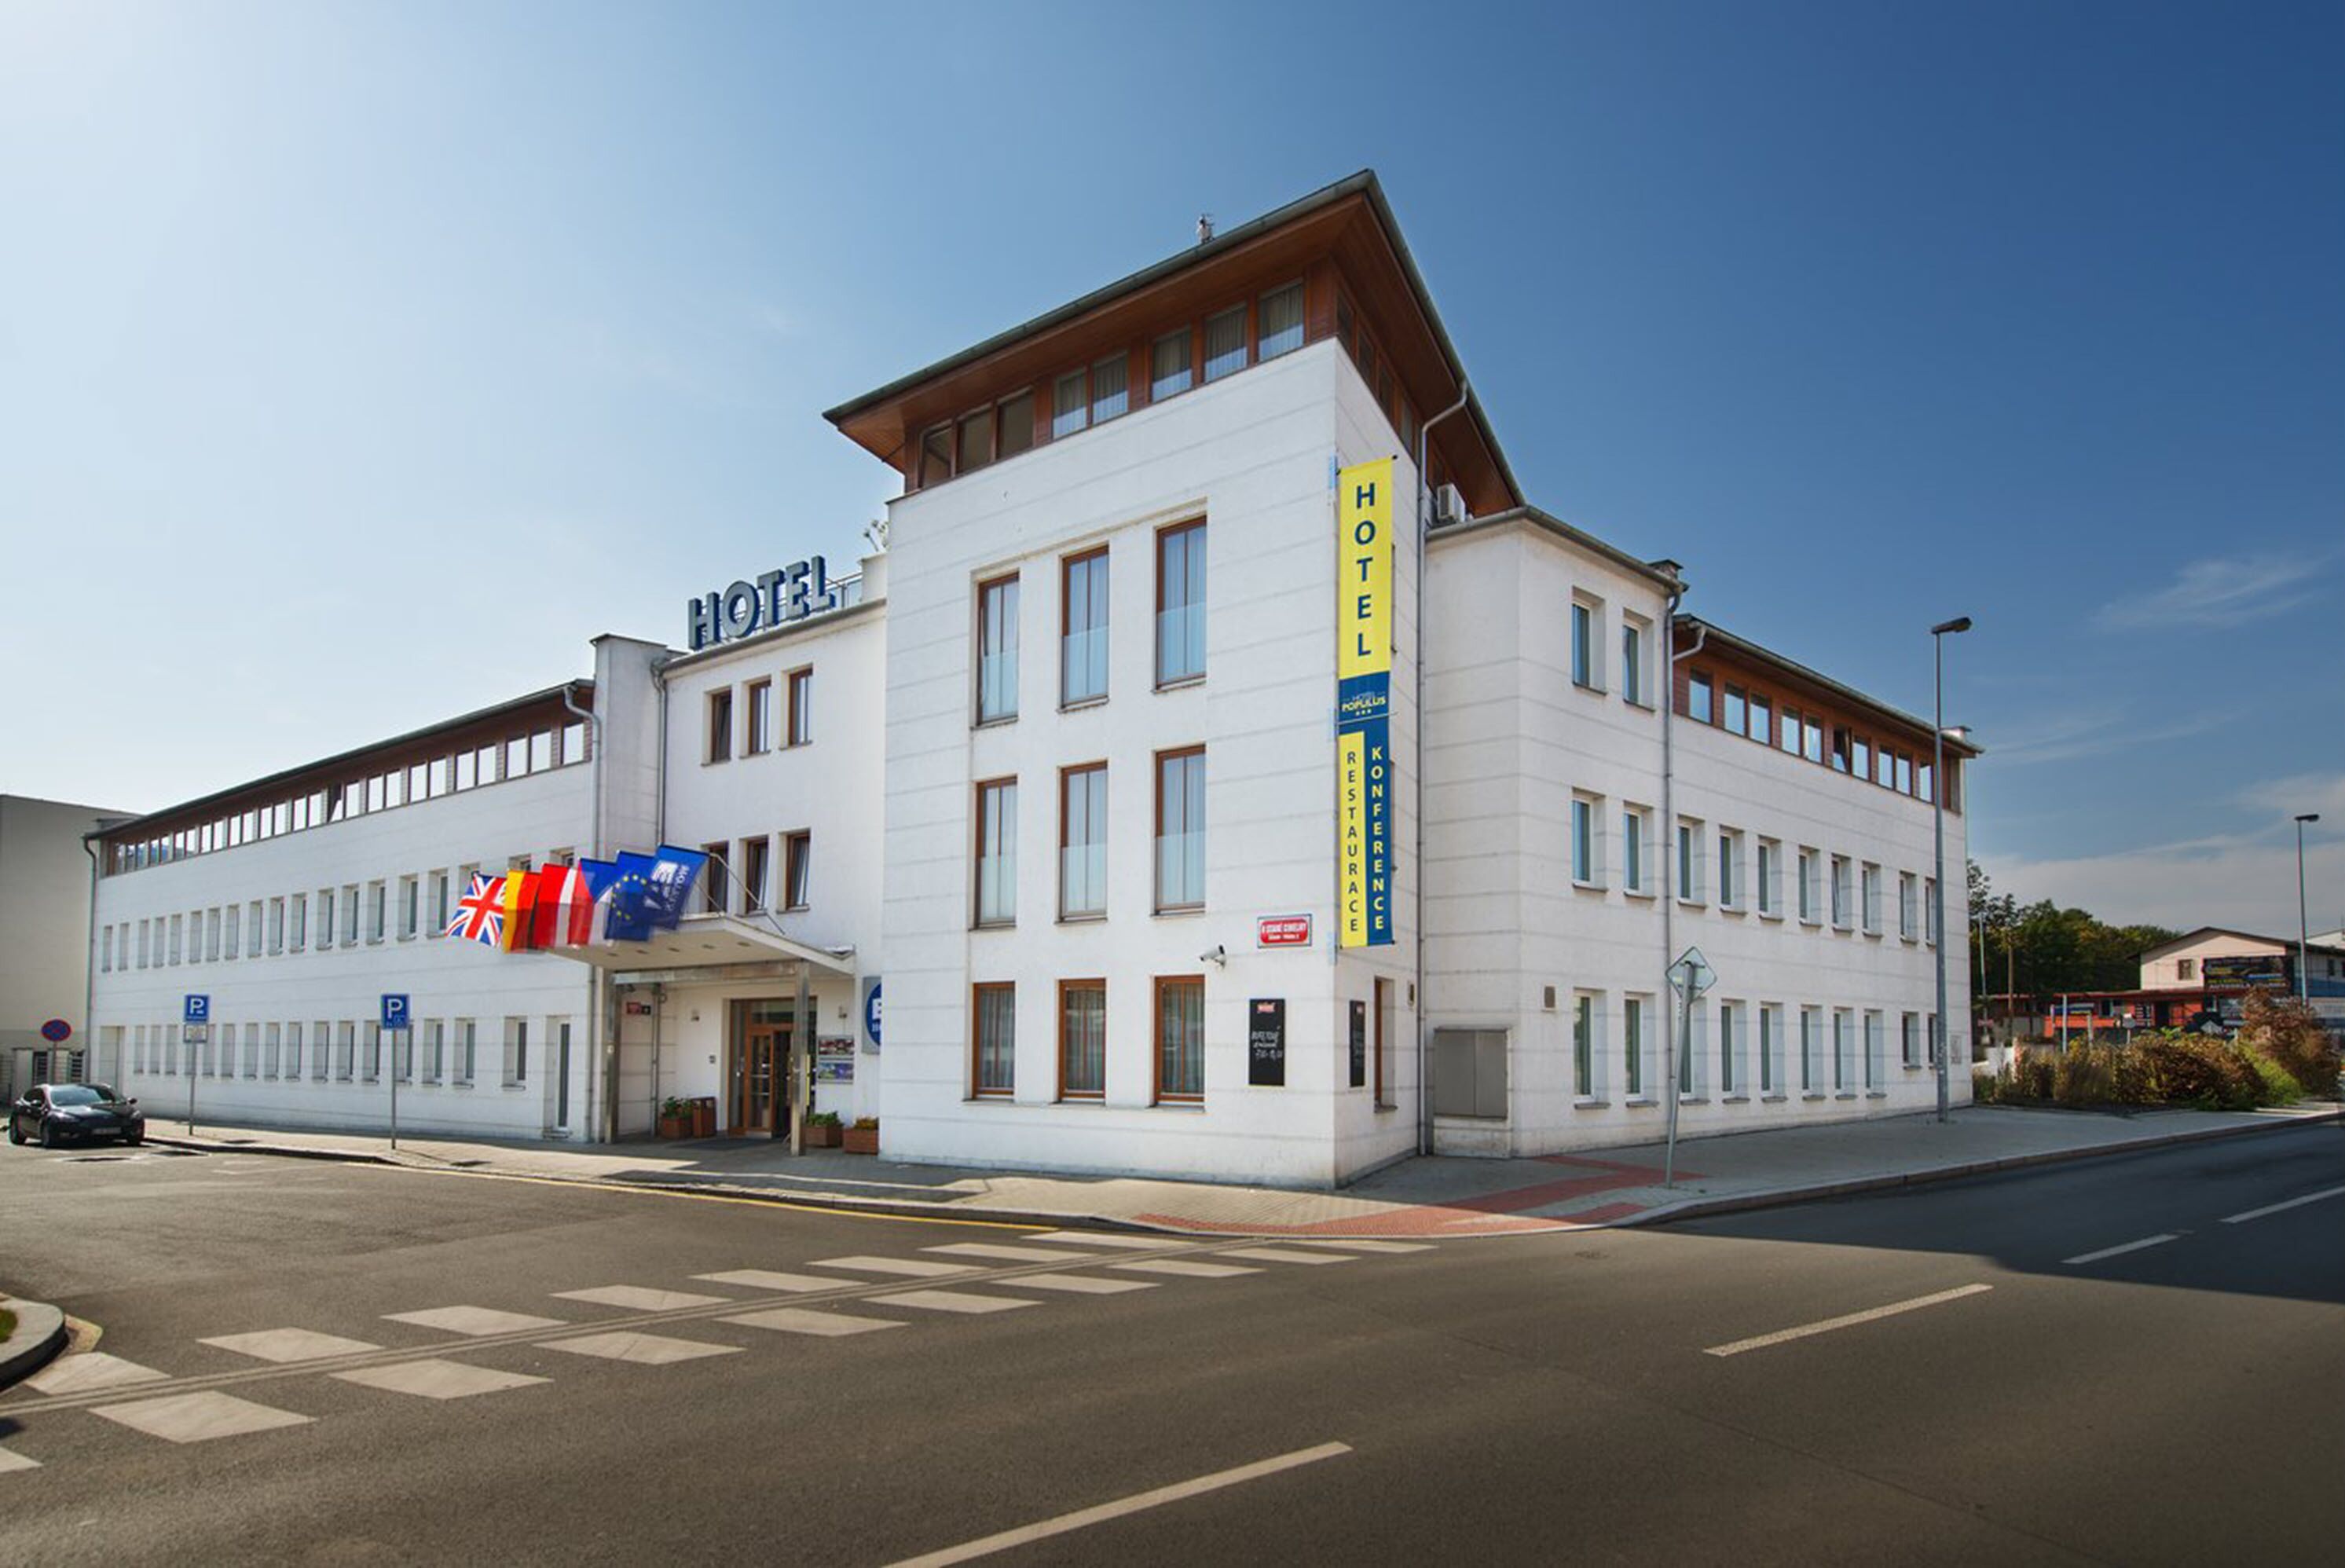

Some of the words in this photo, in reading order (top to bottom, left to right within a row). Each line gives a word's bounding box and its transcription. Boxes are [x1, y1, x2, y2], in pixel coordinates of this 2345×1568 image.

[687, 555, 836, 651] HOTEL
[1354, 482, 1376, 657] HOTEL
[1347, 750, 1359, 932] RESTAURACE
[1371, 746, 1384, 930] KONFERENCE
[189, 998, 204, 1014] P
[387, 998, 403, 1019] P
